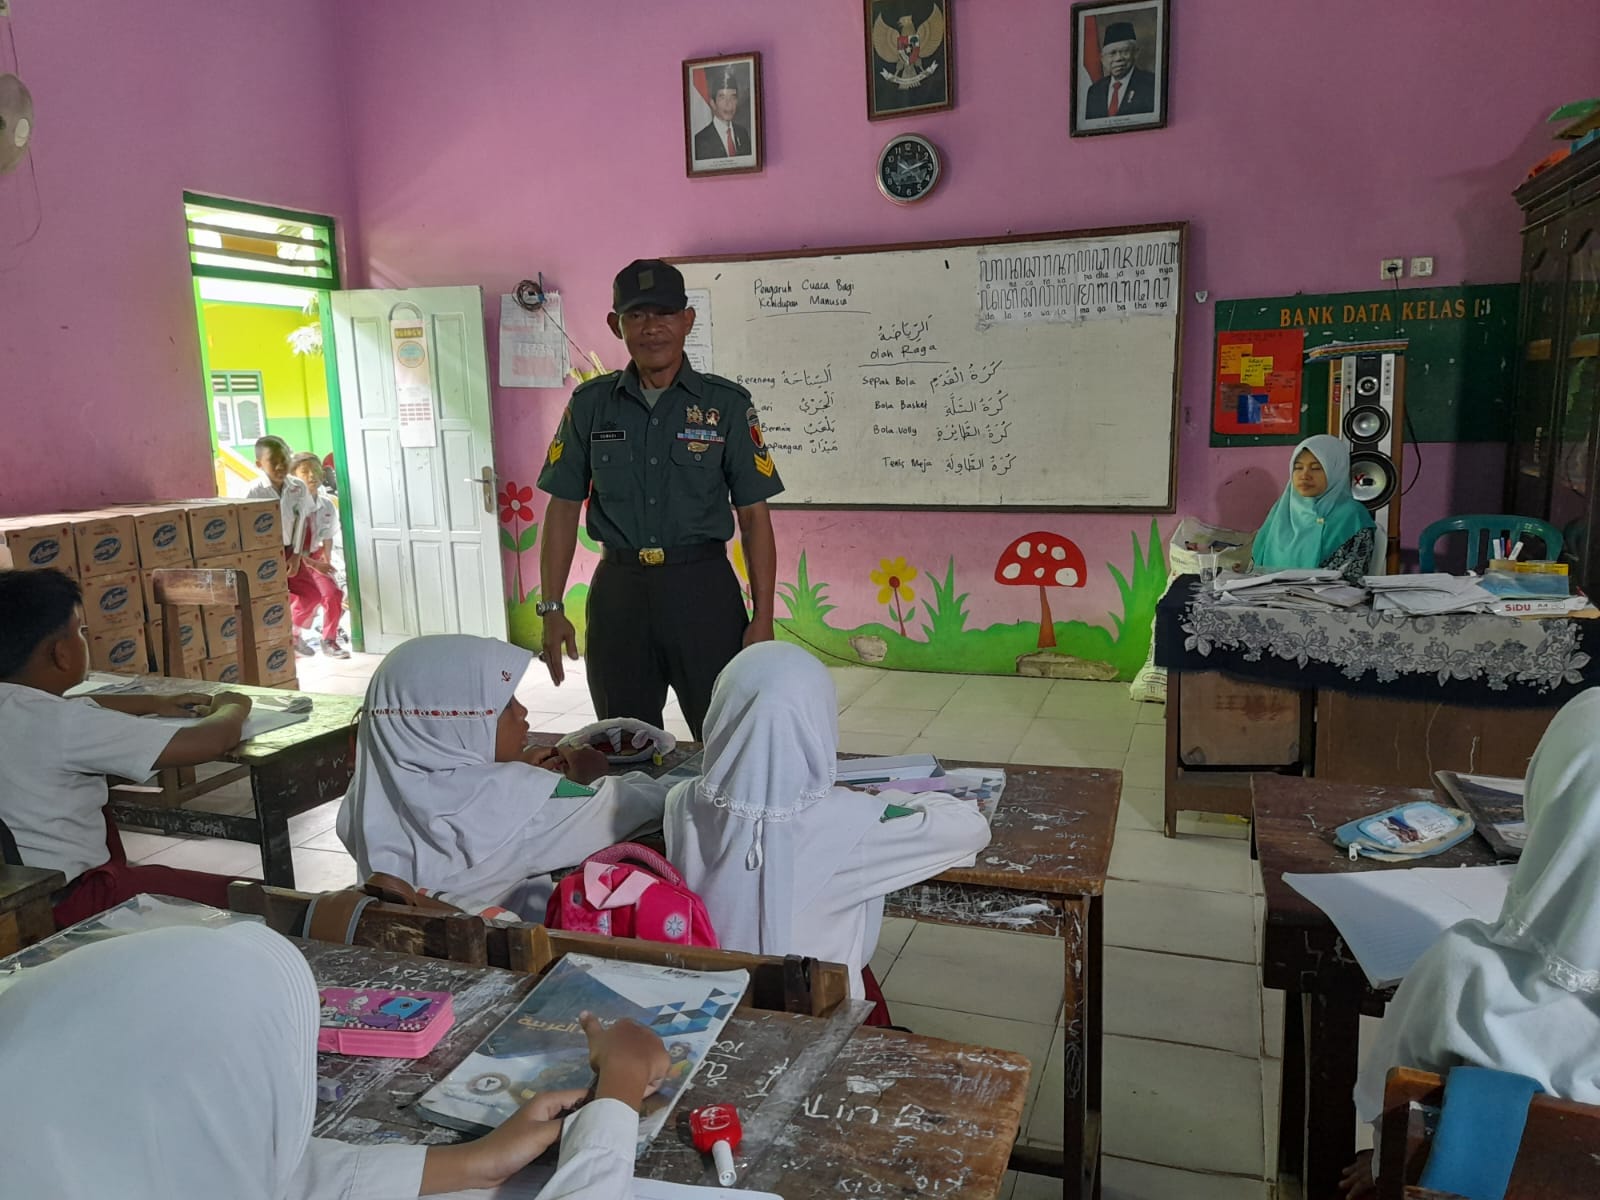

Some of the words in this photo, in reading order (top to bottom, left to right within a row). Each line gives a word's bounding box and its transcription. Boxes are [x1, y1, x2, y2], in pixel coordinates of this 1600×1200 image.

[754, 278, 792, 298] Pengaruh
[802, 279, 830, 290] Cuaca
[1280, 306, 1335, 327] BANK
[1343, 303, 1392, 323] DATA
[1402, 299, 1466, 320] KELAS
[901, 344, 937, 358] Raga
[896, 376, 916, 386] Bola
[874, 400, 894, 410] Bola
[900, 399, 928, 410] Basket
[873, 424, 894, 434] Bola
